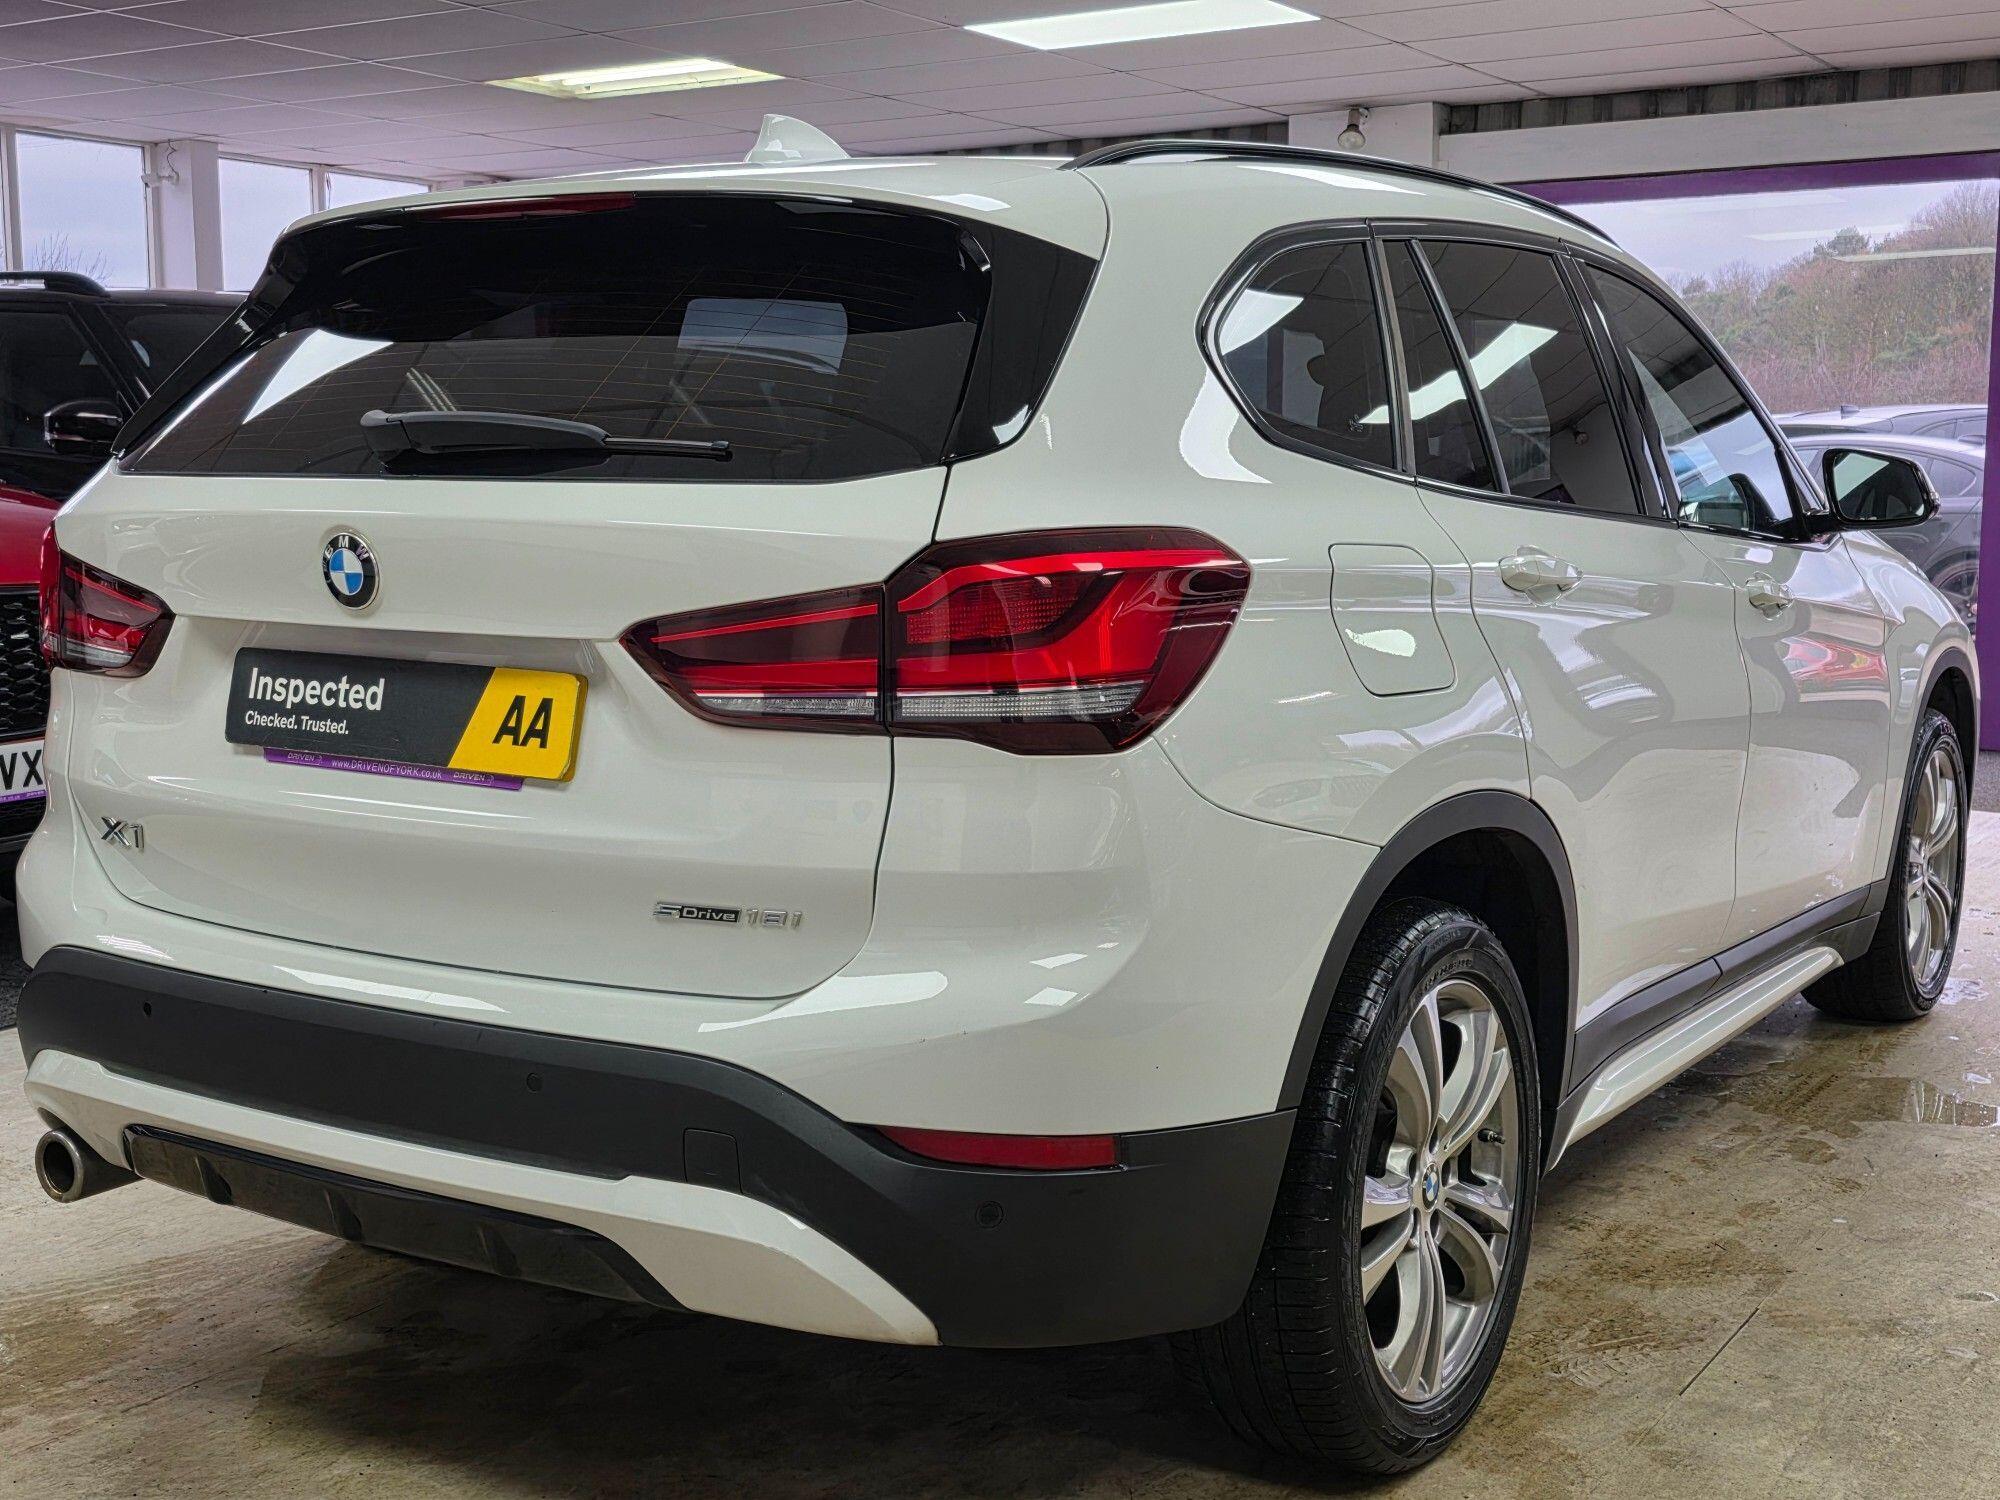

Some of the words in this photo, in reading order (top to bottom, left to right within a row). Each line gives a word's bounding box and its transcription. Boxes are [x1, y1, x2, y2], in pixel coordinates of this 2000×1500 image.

[324, 535, 370, 561] BMW
[248, 667, 386, 711] Inspected
[245, 710, 298, 730] Checked.
[300, 715, 349, 735] Trusted.
[492, 694, 554, 749] AA
[453, 771, 485, 781] DRIVEN
[101, 816, 145, 849] X1
